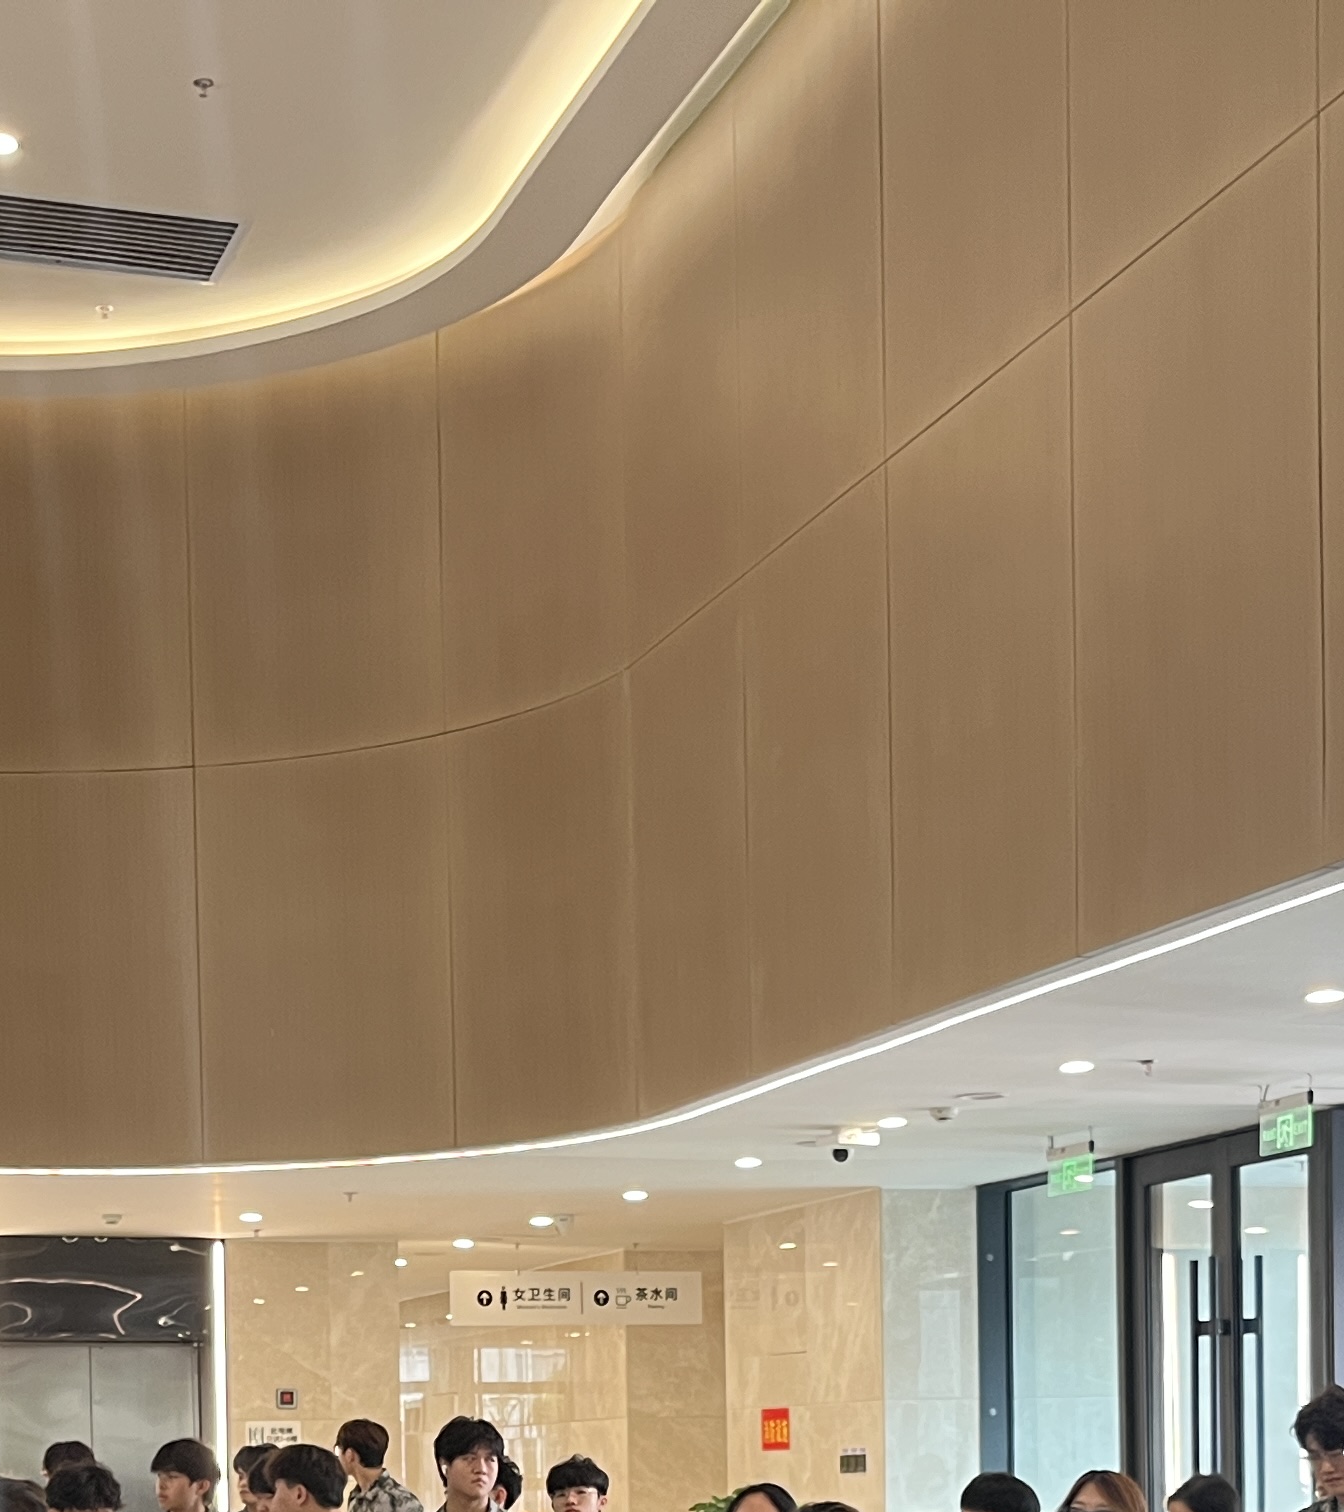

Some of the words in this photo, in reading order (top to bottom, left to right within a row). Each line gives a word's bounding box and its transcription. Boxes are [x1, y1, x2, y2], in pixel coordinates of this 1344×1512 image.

[512, 1287, 571, 1302] 女卫生间
[635, 1287, 678, 1302] 茶水间
